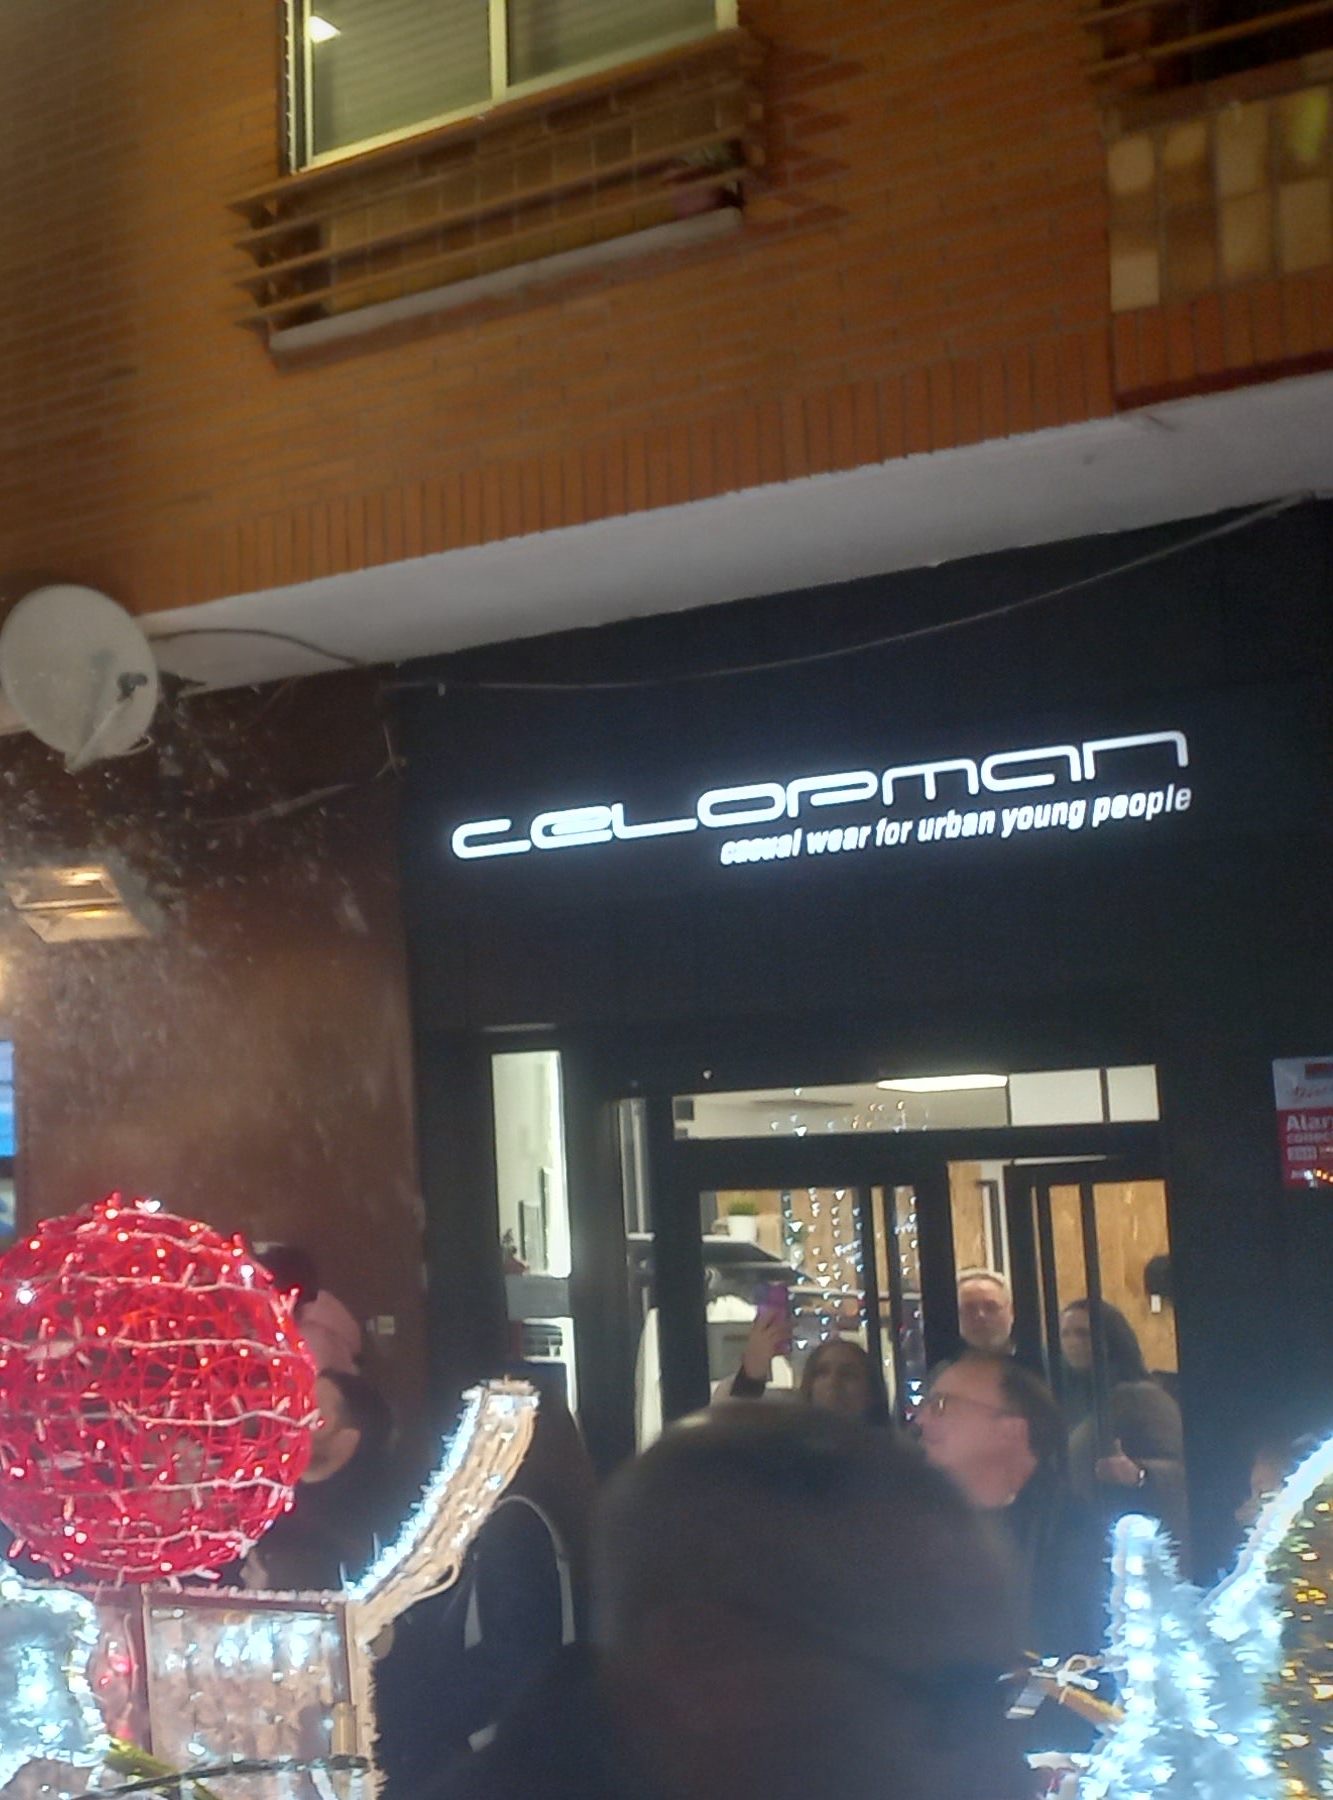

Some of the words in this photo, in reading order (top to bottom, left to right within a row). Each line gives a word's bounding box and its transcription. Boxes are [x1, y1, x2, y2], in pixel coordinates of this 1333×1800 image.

[720, 827, 803, 866] casual
[806, 824, 872, 855] wear
[875, 817, 914, 847] for
[917, 808, 996, 842] urban
[1000, 799, 1087, 839] young
[1091, 783, 1192, 828] people
[1286, 1113, 1333, 1132] Alar
